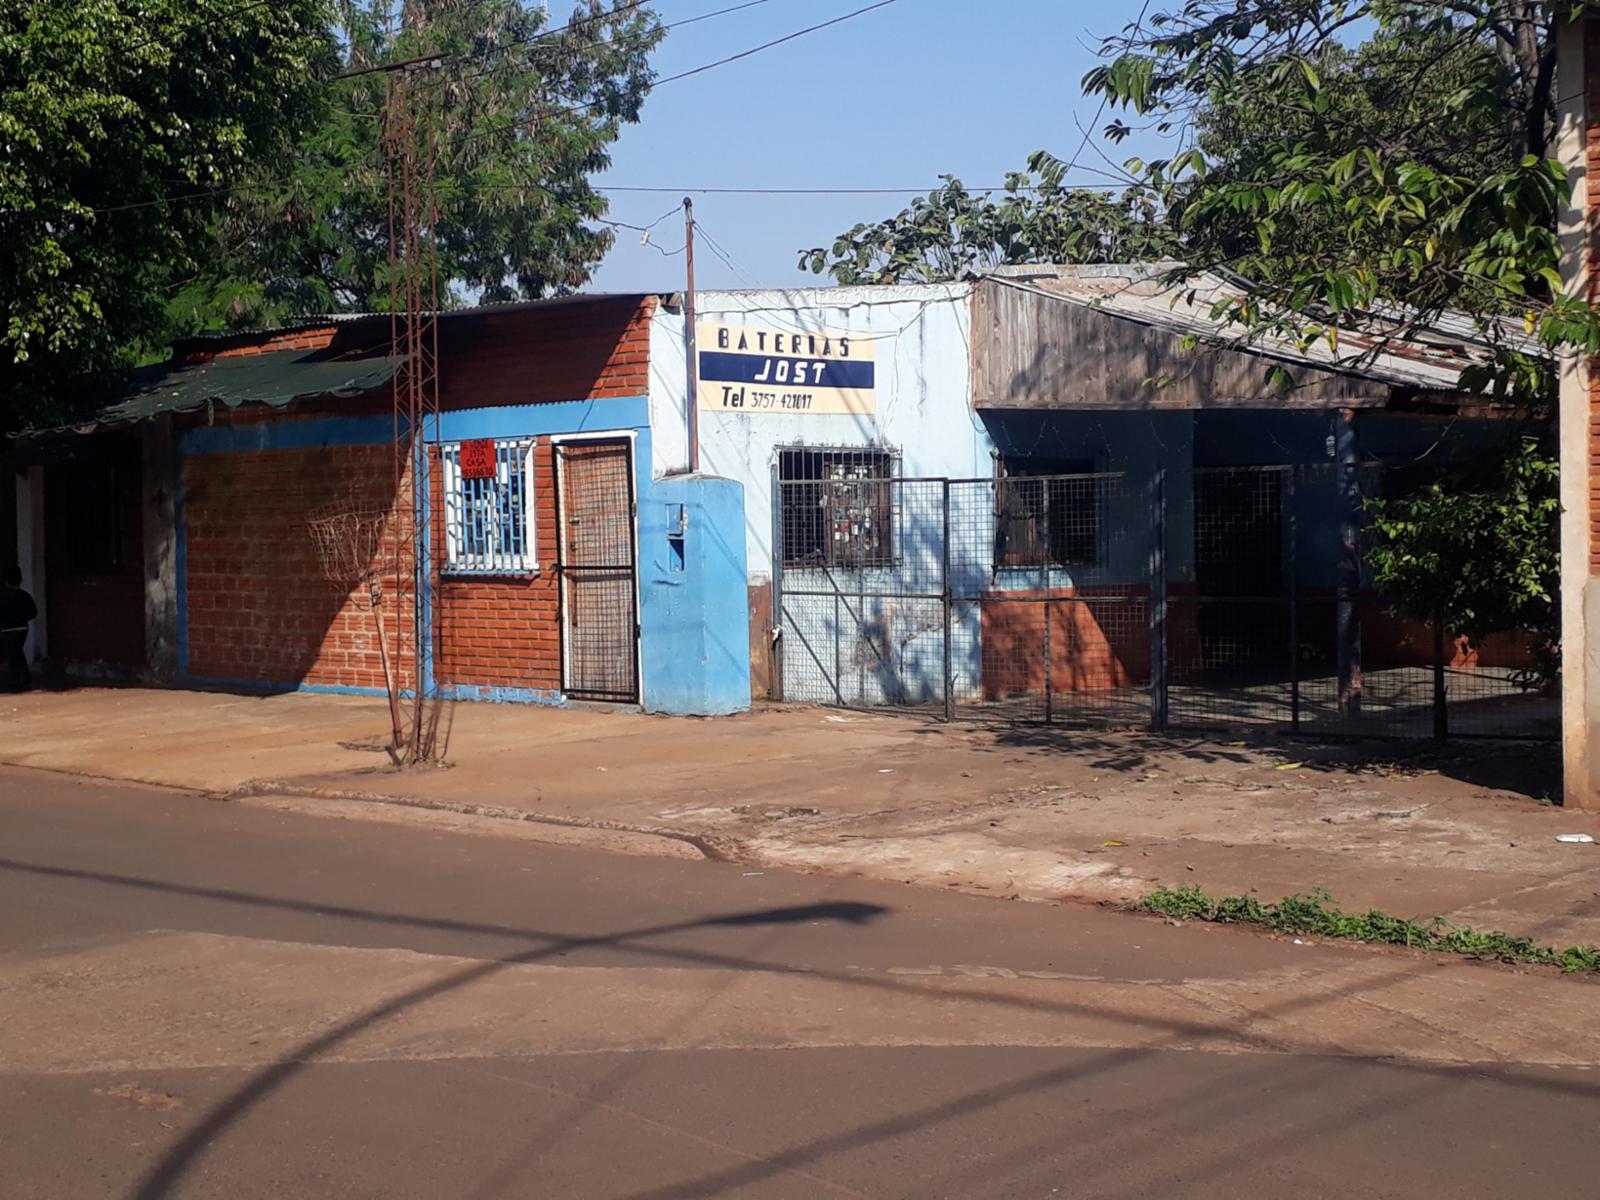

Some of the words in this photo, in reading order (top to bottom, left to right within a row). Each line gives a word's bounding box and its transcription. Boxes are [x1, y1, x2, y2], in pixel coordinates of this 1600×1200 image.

[718, 327, 849, 357] BATERIAS
[754, 359, 826, 384] JOST
[722, 386, 745, 407] Tel
